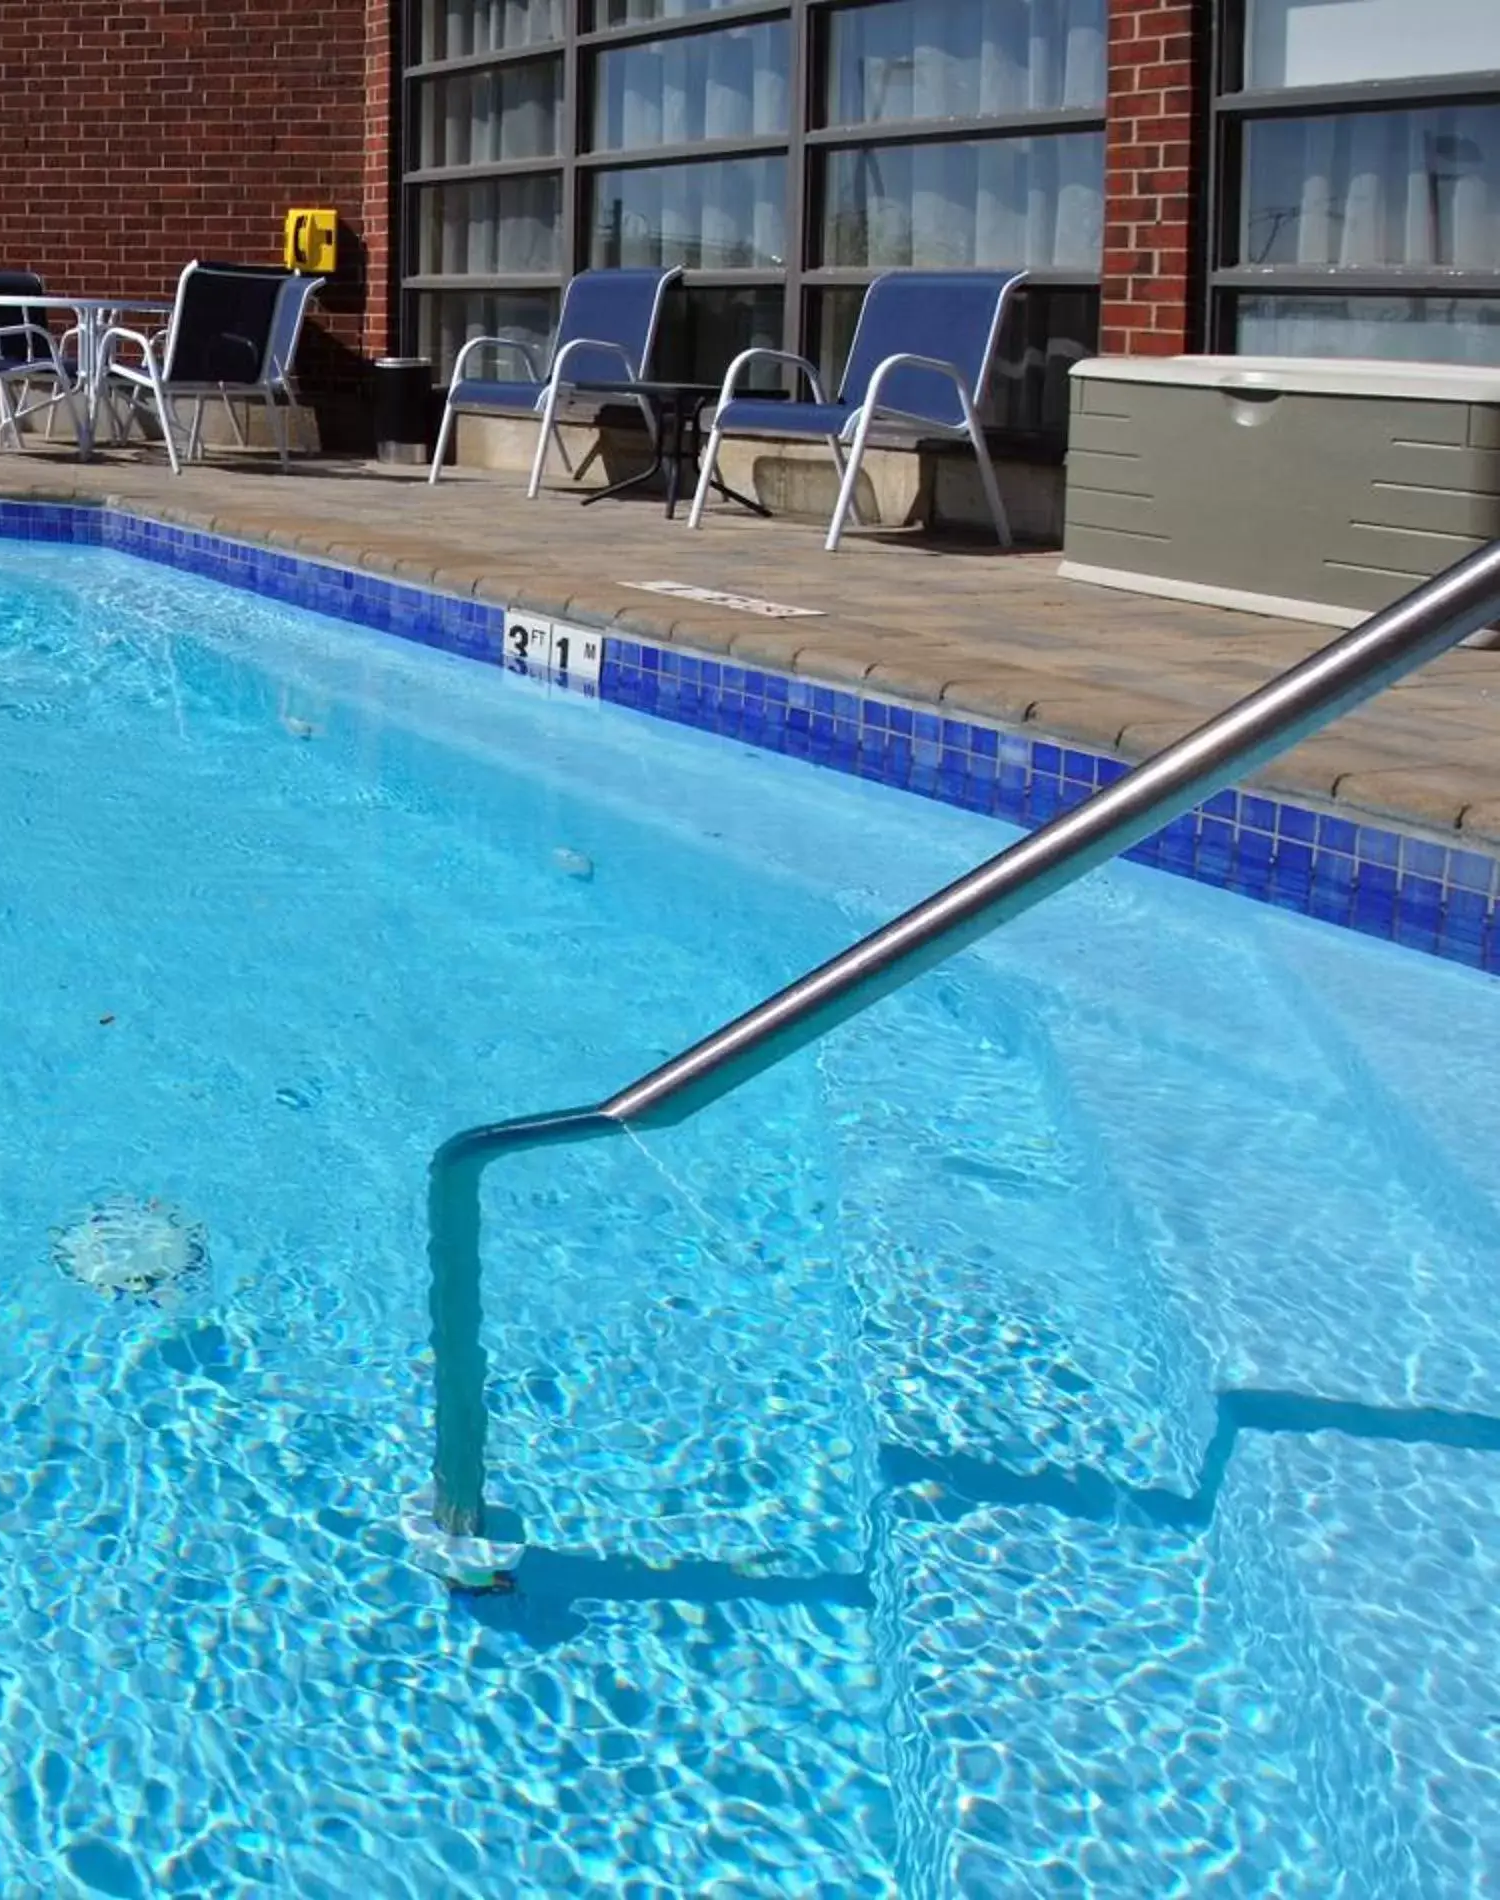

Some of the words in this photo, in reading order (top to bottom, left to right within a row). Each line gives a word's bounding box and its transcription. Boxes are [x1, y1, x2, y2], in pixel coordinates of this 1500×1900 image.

[509, 625, 528, 657] 3
[531, 629, 546, 647] FT
[556, 637, 569, 670] 1
[584, 642, 596, 660] M
